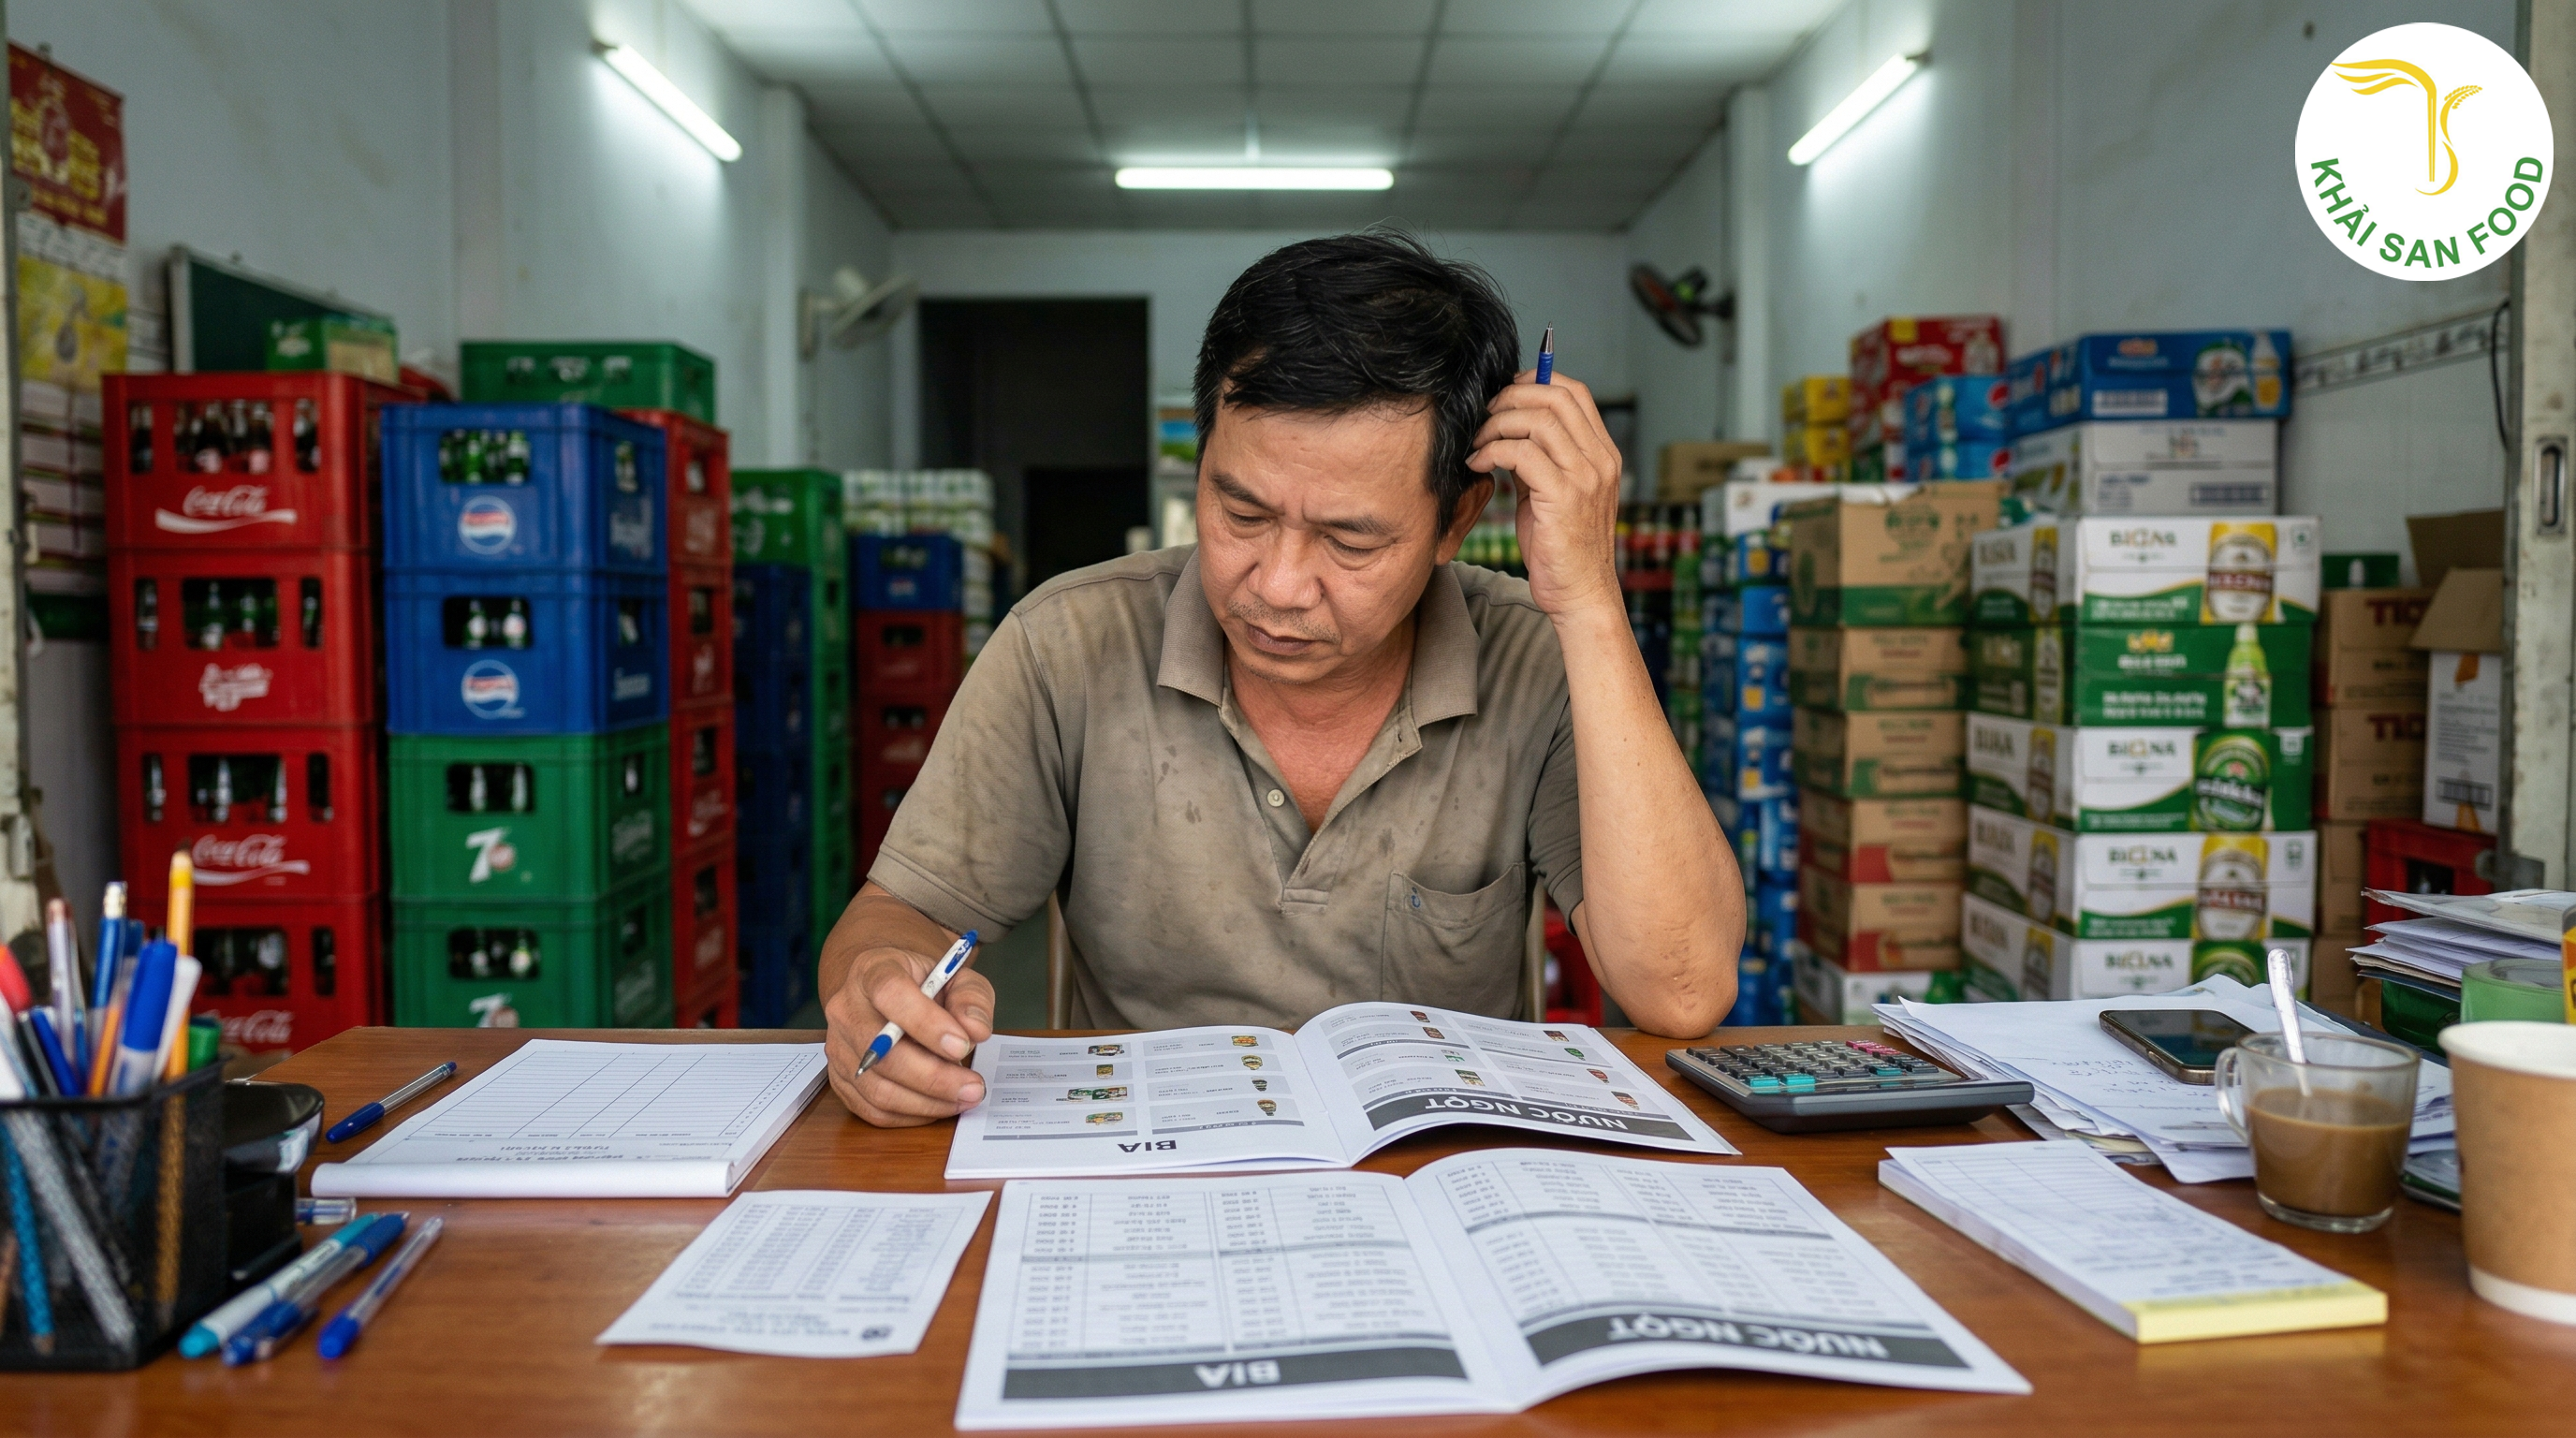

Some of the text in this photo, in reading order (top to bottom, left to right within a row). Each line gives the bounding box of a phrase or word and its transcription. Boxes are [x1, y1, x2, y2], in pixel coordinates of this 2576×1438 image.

[1425, 1095, 1522, 1115] NGỌT
[1117, 1139, 1178, 1153] BIA
[1193, 1359, 1281, 1388] BIA
